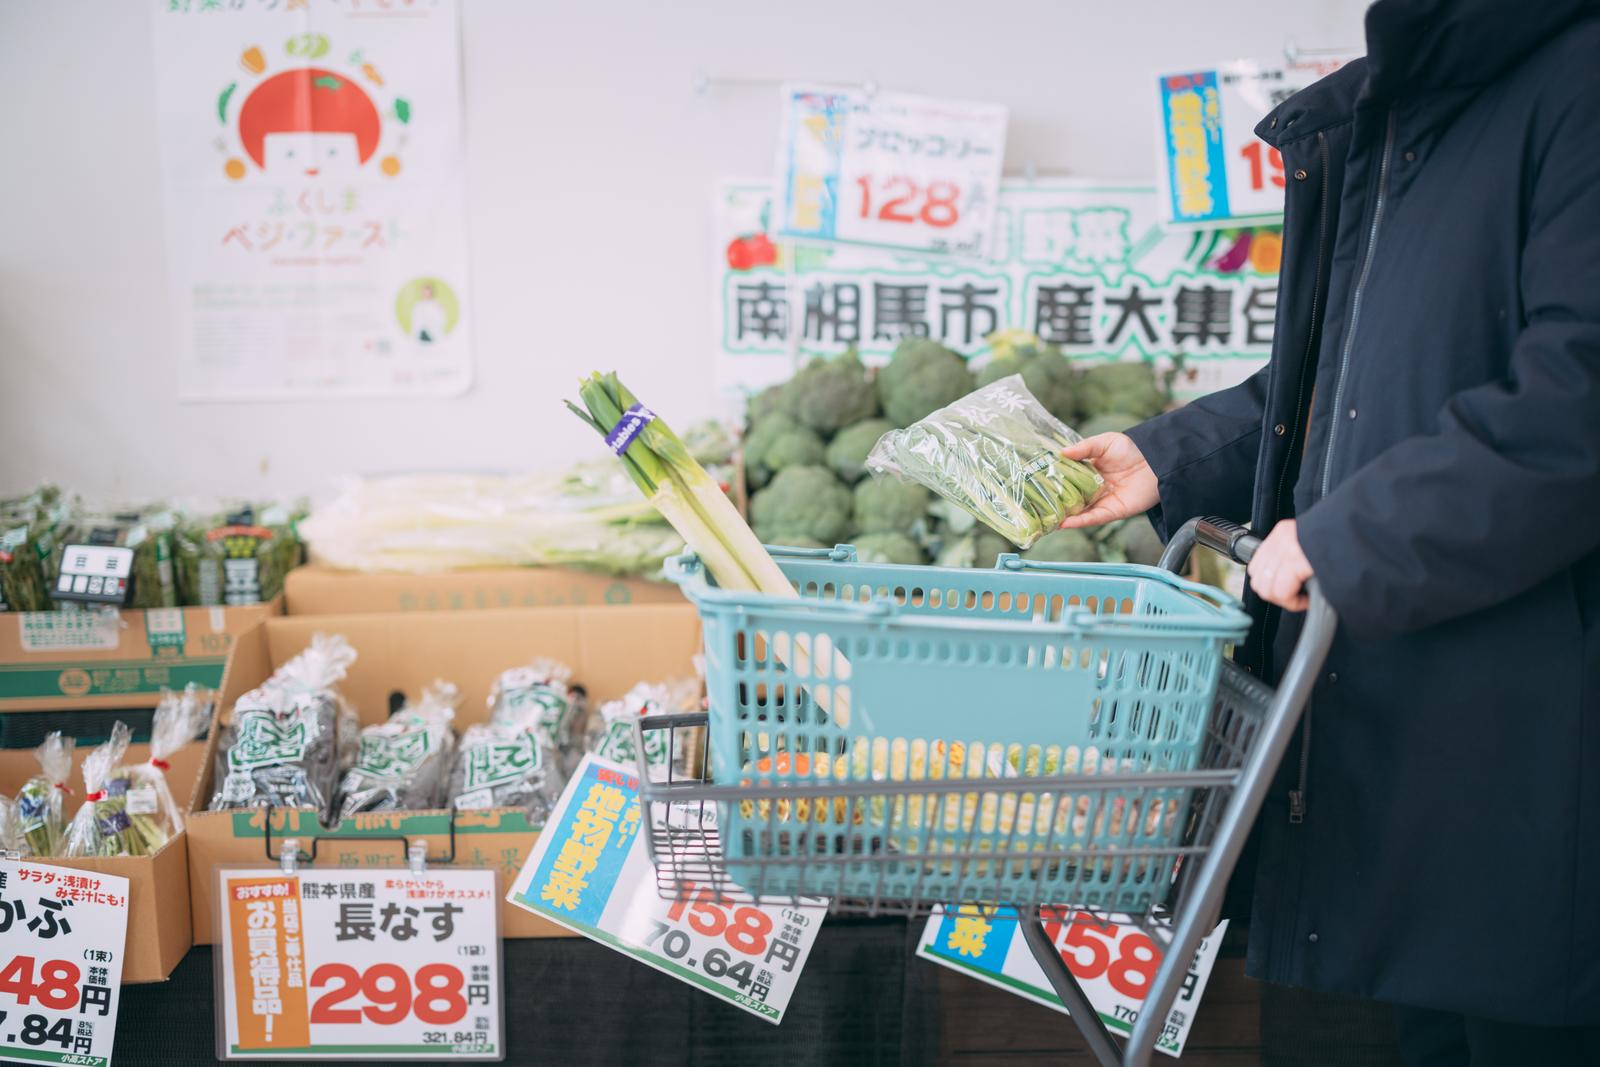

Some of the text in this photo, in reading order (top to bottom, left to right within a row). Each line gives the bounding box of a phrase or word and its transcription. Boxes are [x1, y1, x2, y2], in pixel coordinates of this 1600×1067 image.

[856, 174, 960, 229] 128
[541, 783, 626, 911] 地物野菜
[18, 869, 101, 890] サラダ・浅漬け
[56, 887, 125, 907] みそ汁にも!
[302, 883, 376, 900] 熊本県産
[335, 902, 464, 942] 長なす
[764, 937, 801, 973] 円
[80, 985, 112, 1016] 円
[309, 963, 468, 1025] 298
